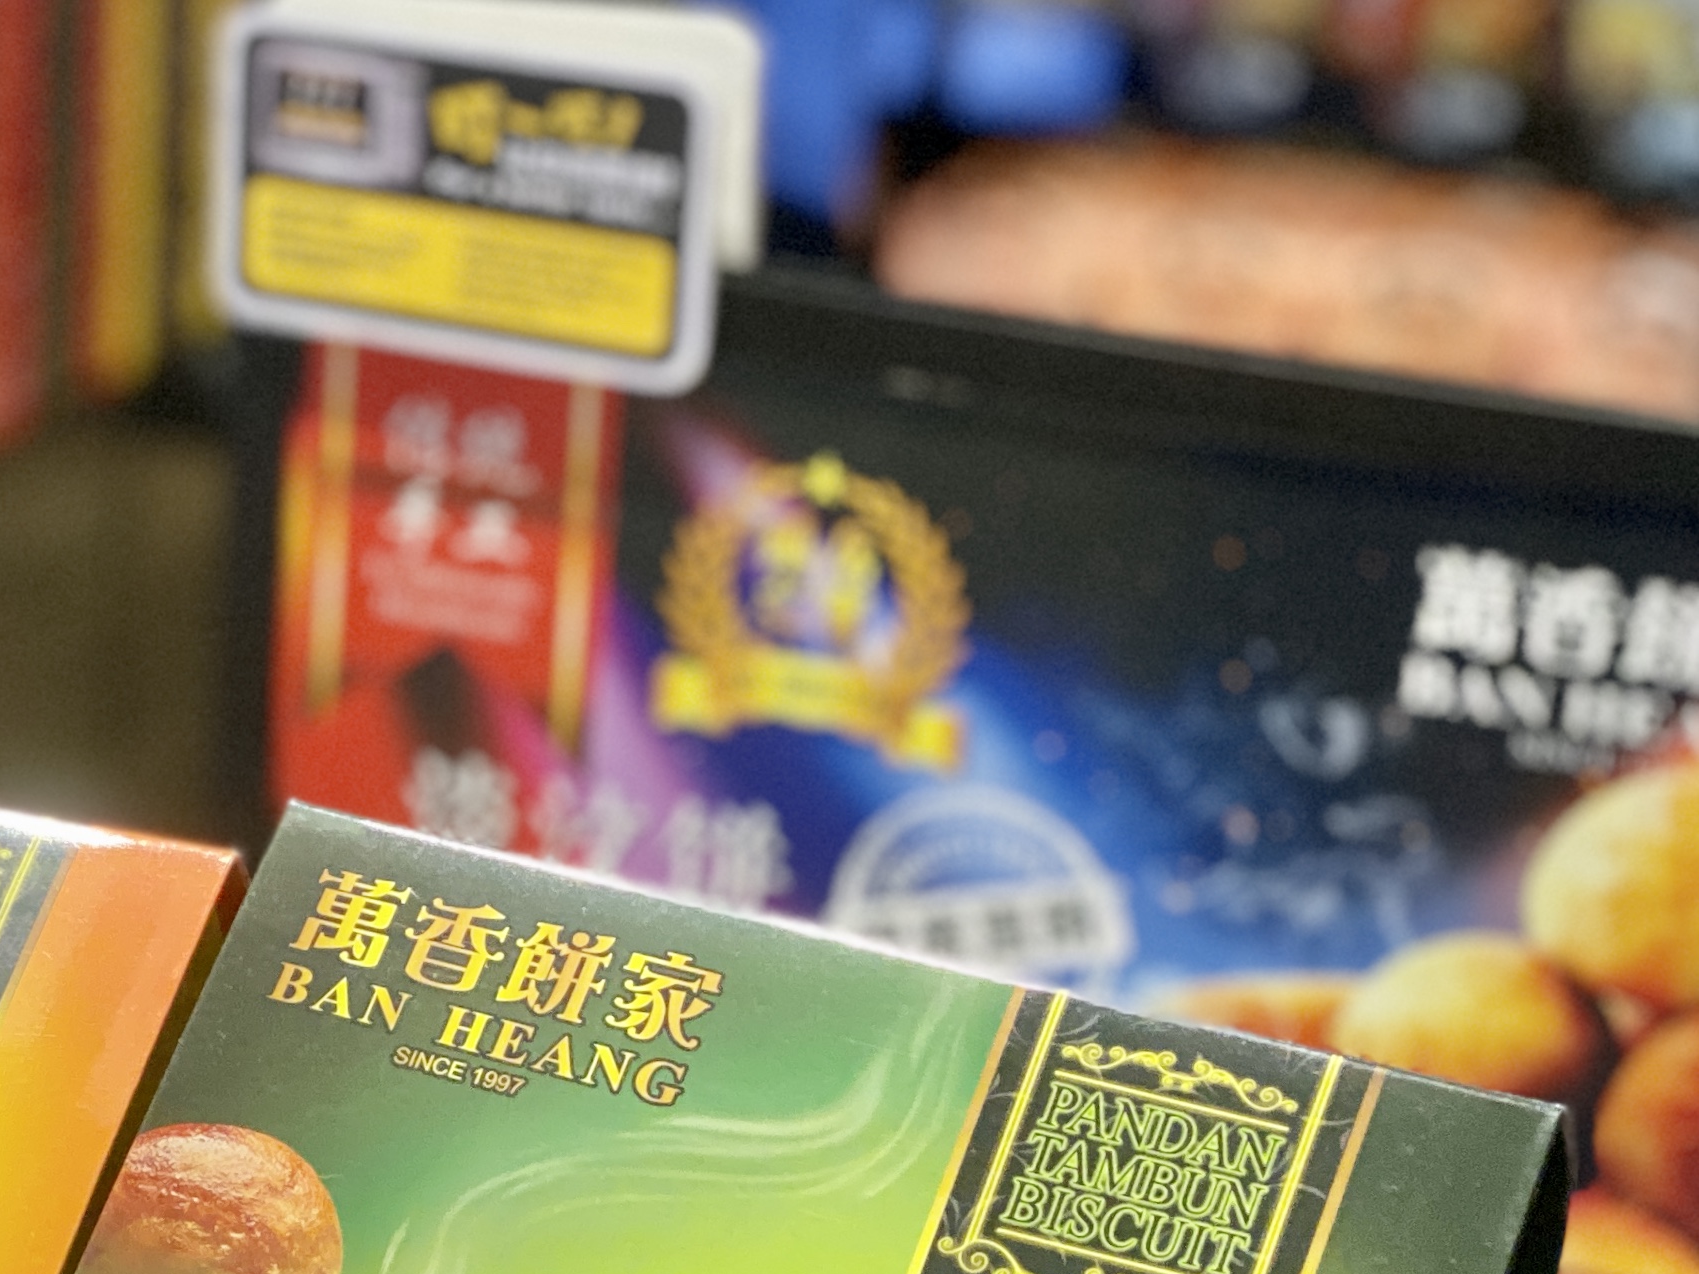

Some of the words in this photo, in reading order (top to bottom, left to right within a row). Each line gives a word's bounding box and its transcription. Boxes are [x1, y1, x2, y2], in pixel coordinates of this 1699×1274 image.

[287, 866, 724, 1052] 萬香餅家
[265, 959, 414, 1033] BAN
[431, 1002, 689, 1107] HEANG
[392, 1045, 468, 1082] SINCE
[469, 1065, 526, 1097] 1997
[1024, 1129, 1269, 1230] TAMBUN
[1038, 1080, 1288, 1182] PANDAN
